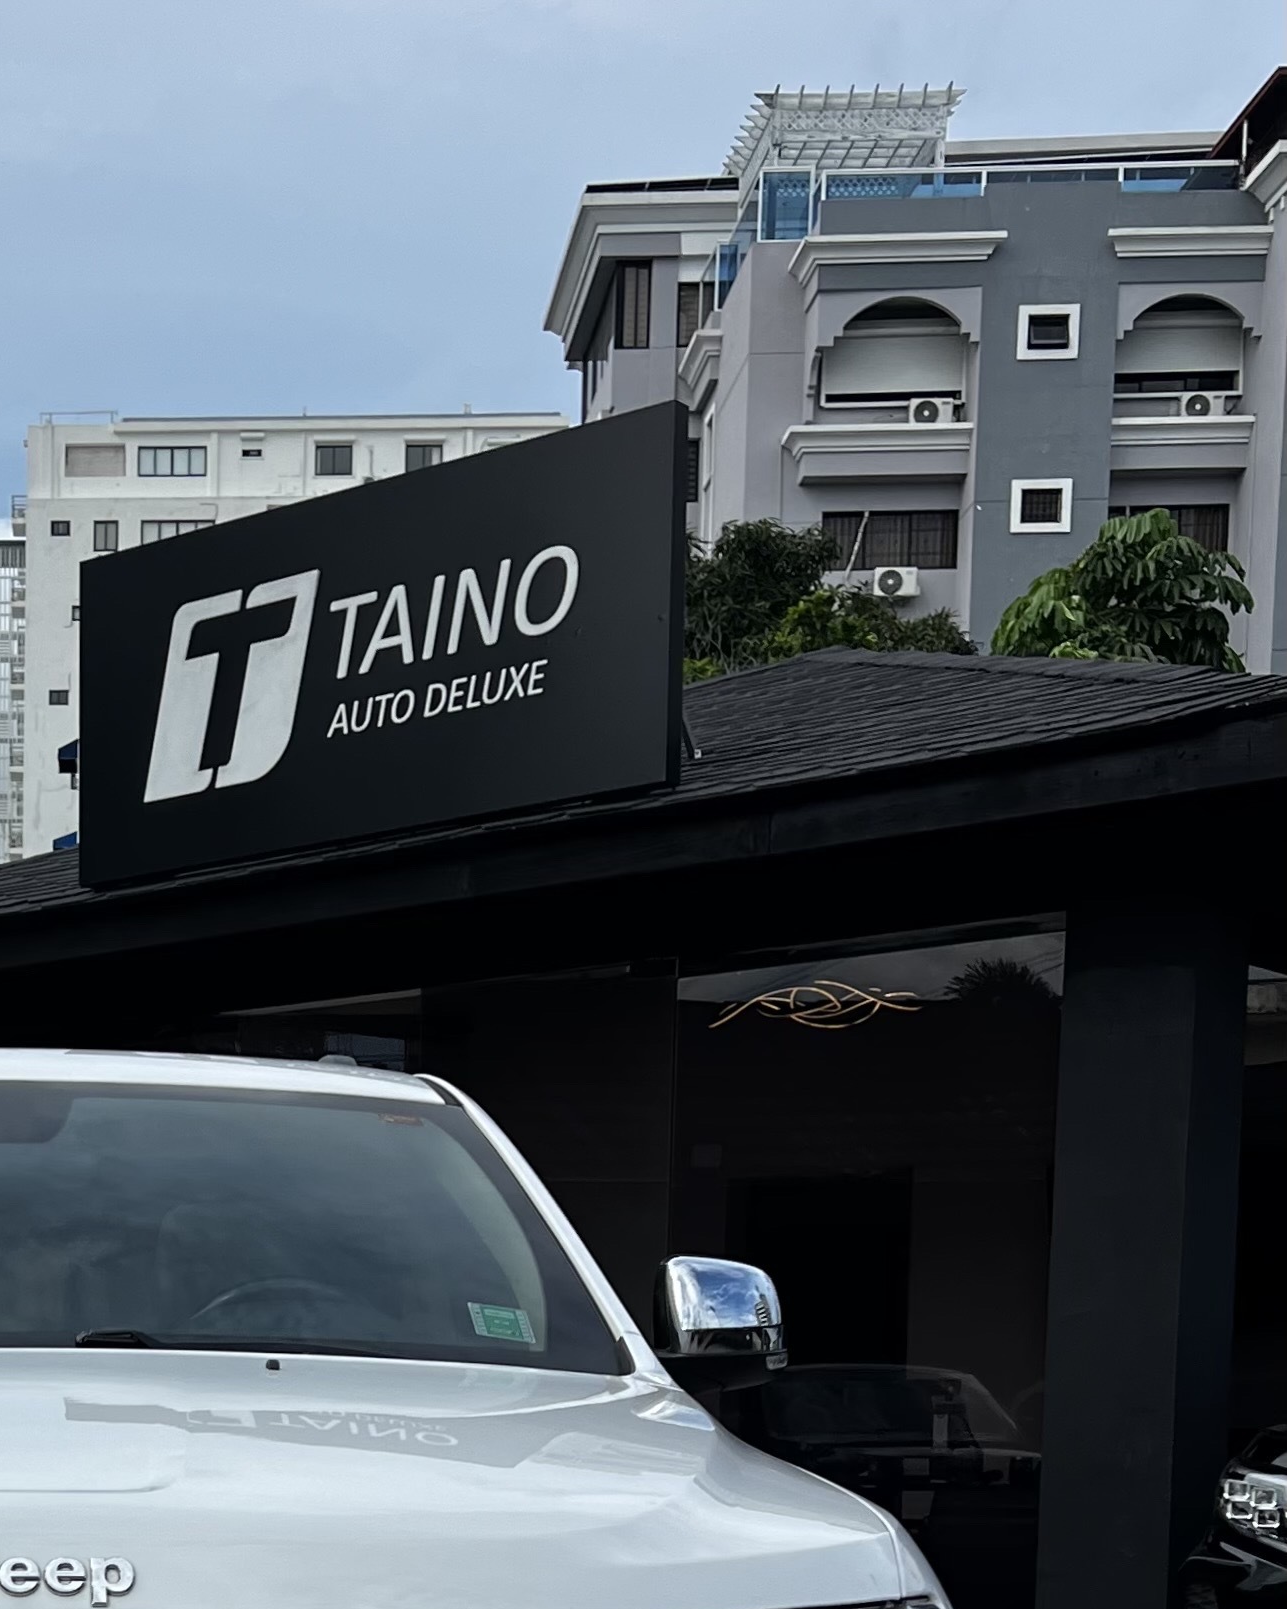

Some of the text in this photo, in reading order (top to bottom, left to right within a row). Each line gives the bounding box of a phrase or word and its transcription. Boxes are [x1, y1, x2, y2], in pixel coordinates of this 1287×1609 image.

[329, 545, 580, 680] TAINO
[326, 659, 550, 738] AUTO DELUXE
